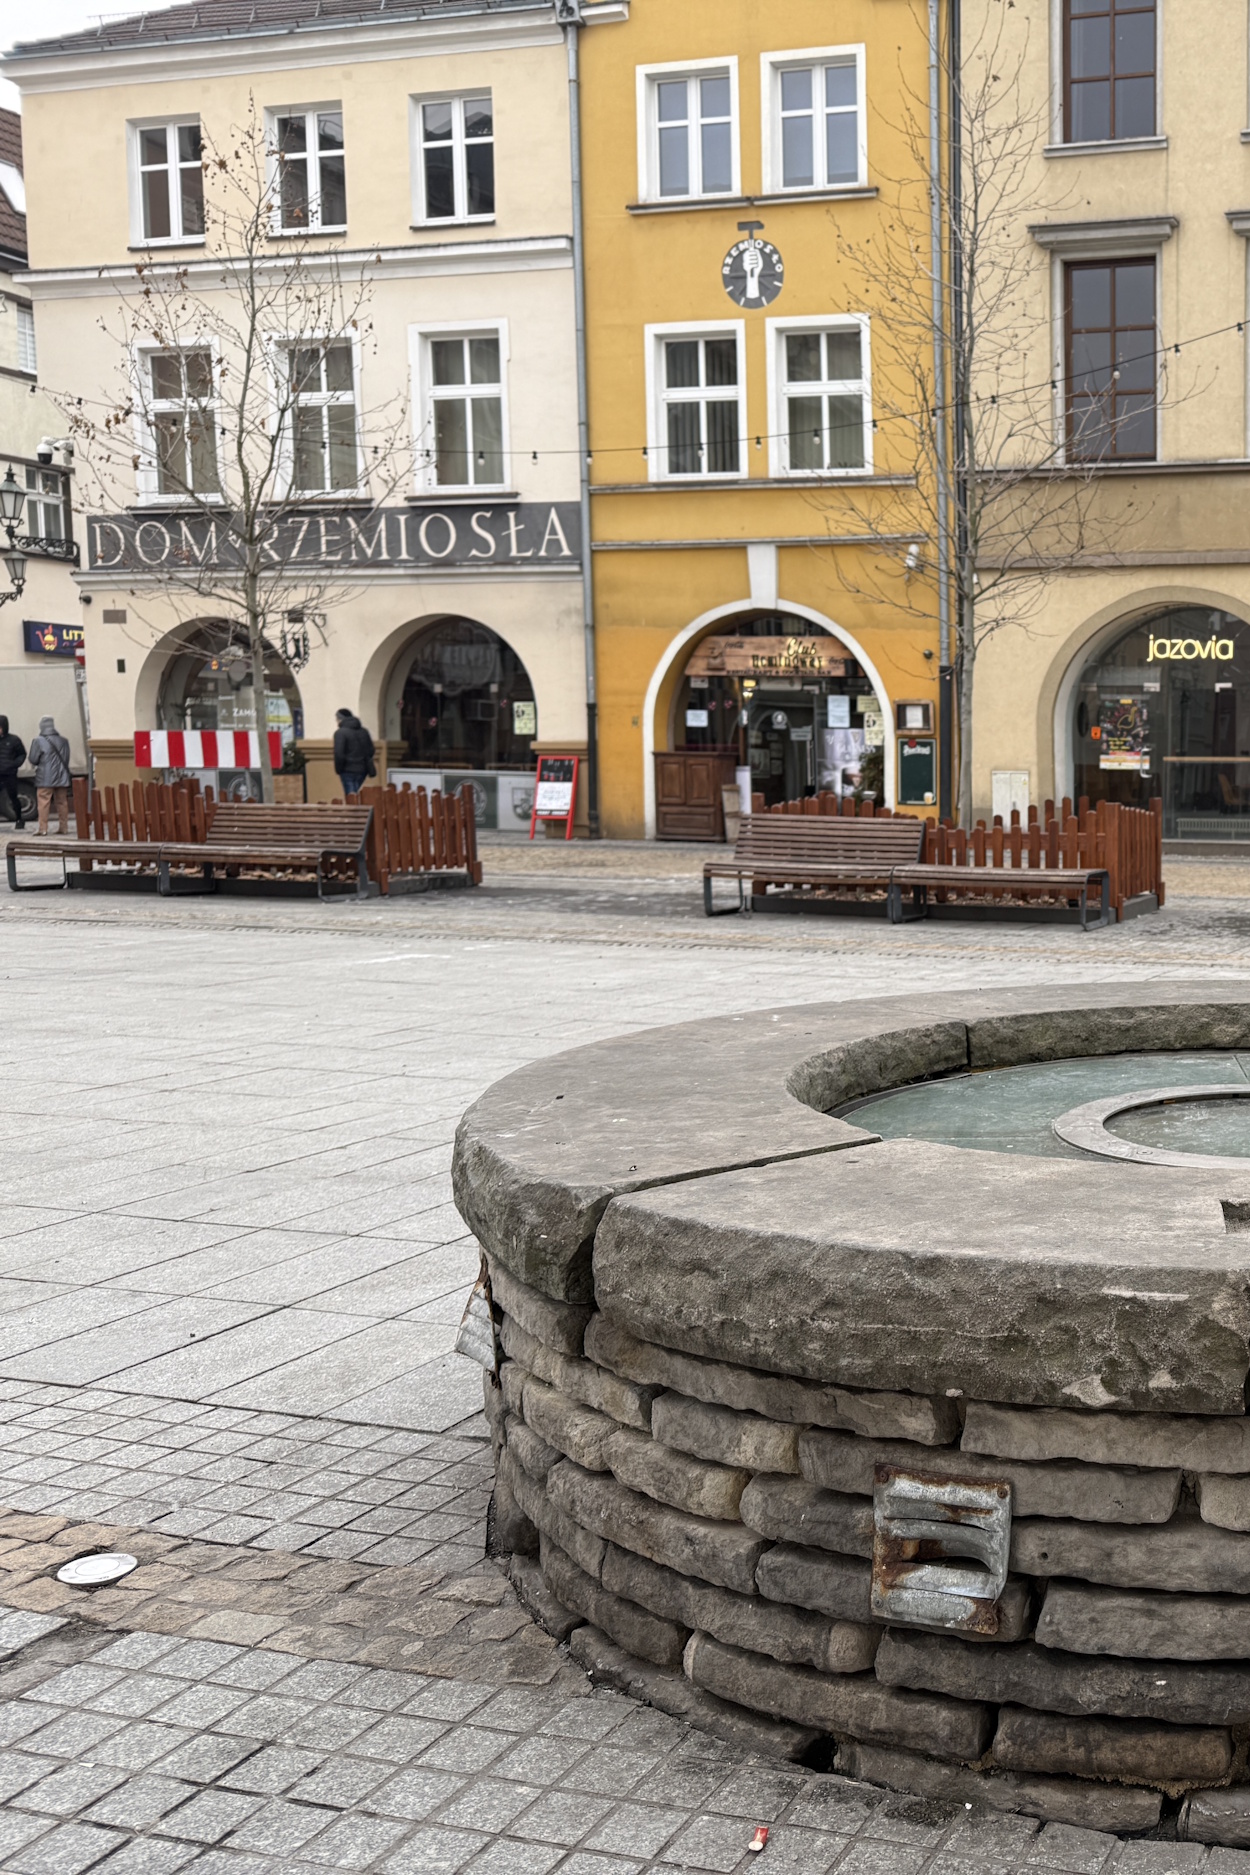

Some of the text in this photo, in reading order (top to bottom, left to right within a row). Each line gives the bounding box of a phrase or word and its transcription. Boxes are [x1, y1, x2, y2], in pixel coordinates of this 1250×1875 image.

[91, 506, 574, 567] DOM RZEMIOSŁA
[786, 637, 817, 656] Club
[1146, 634, 1234, 662] jazovia
